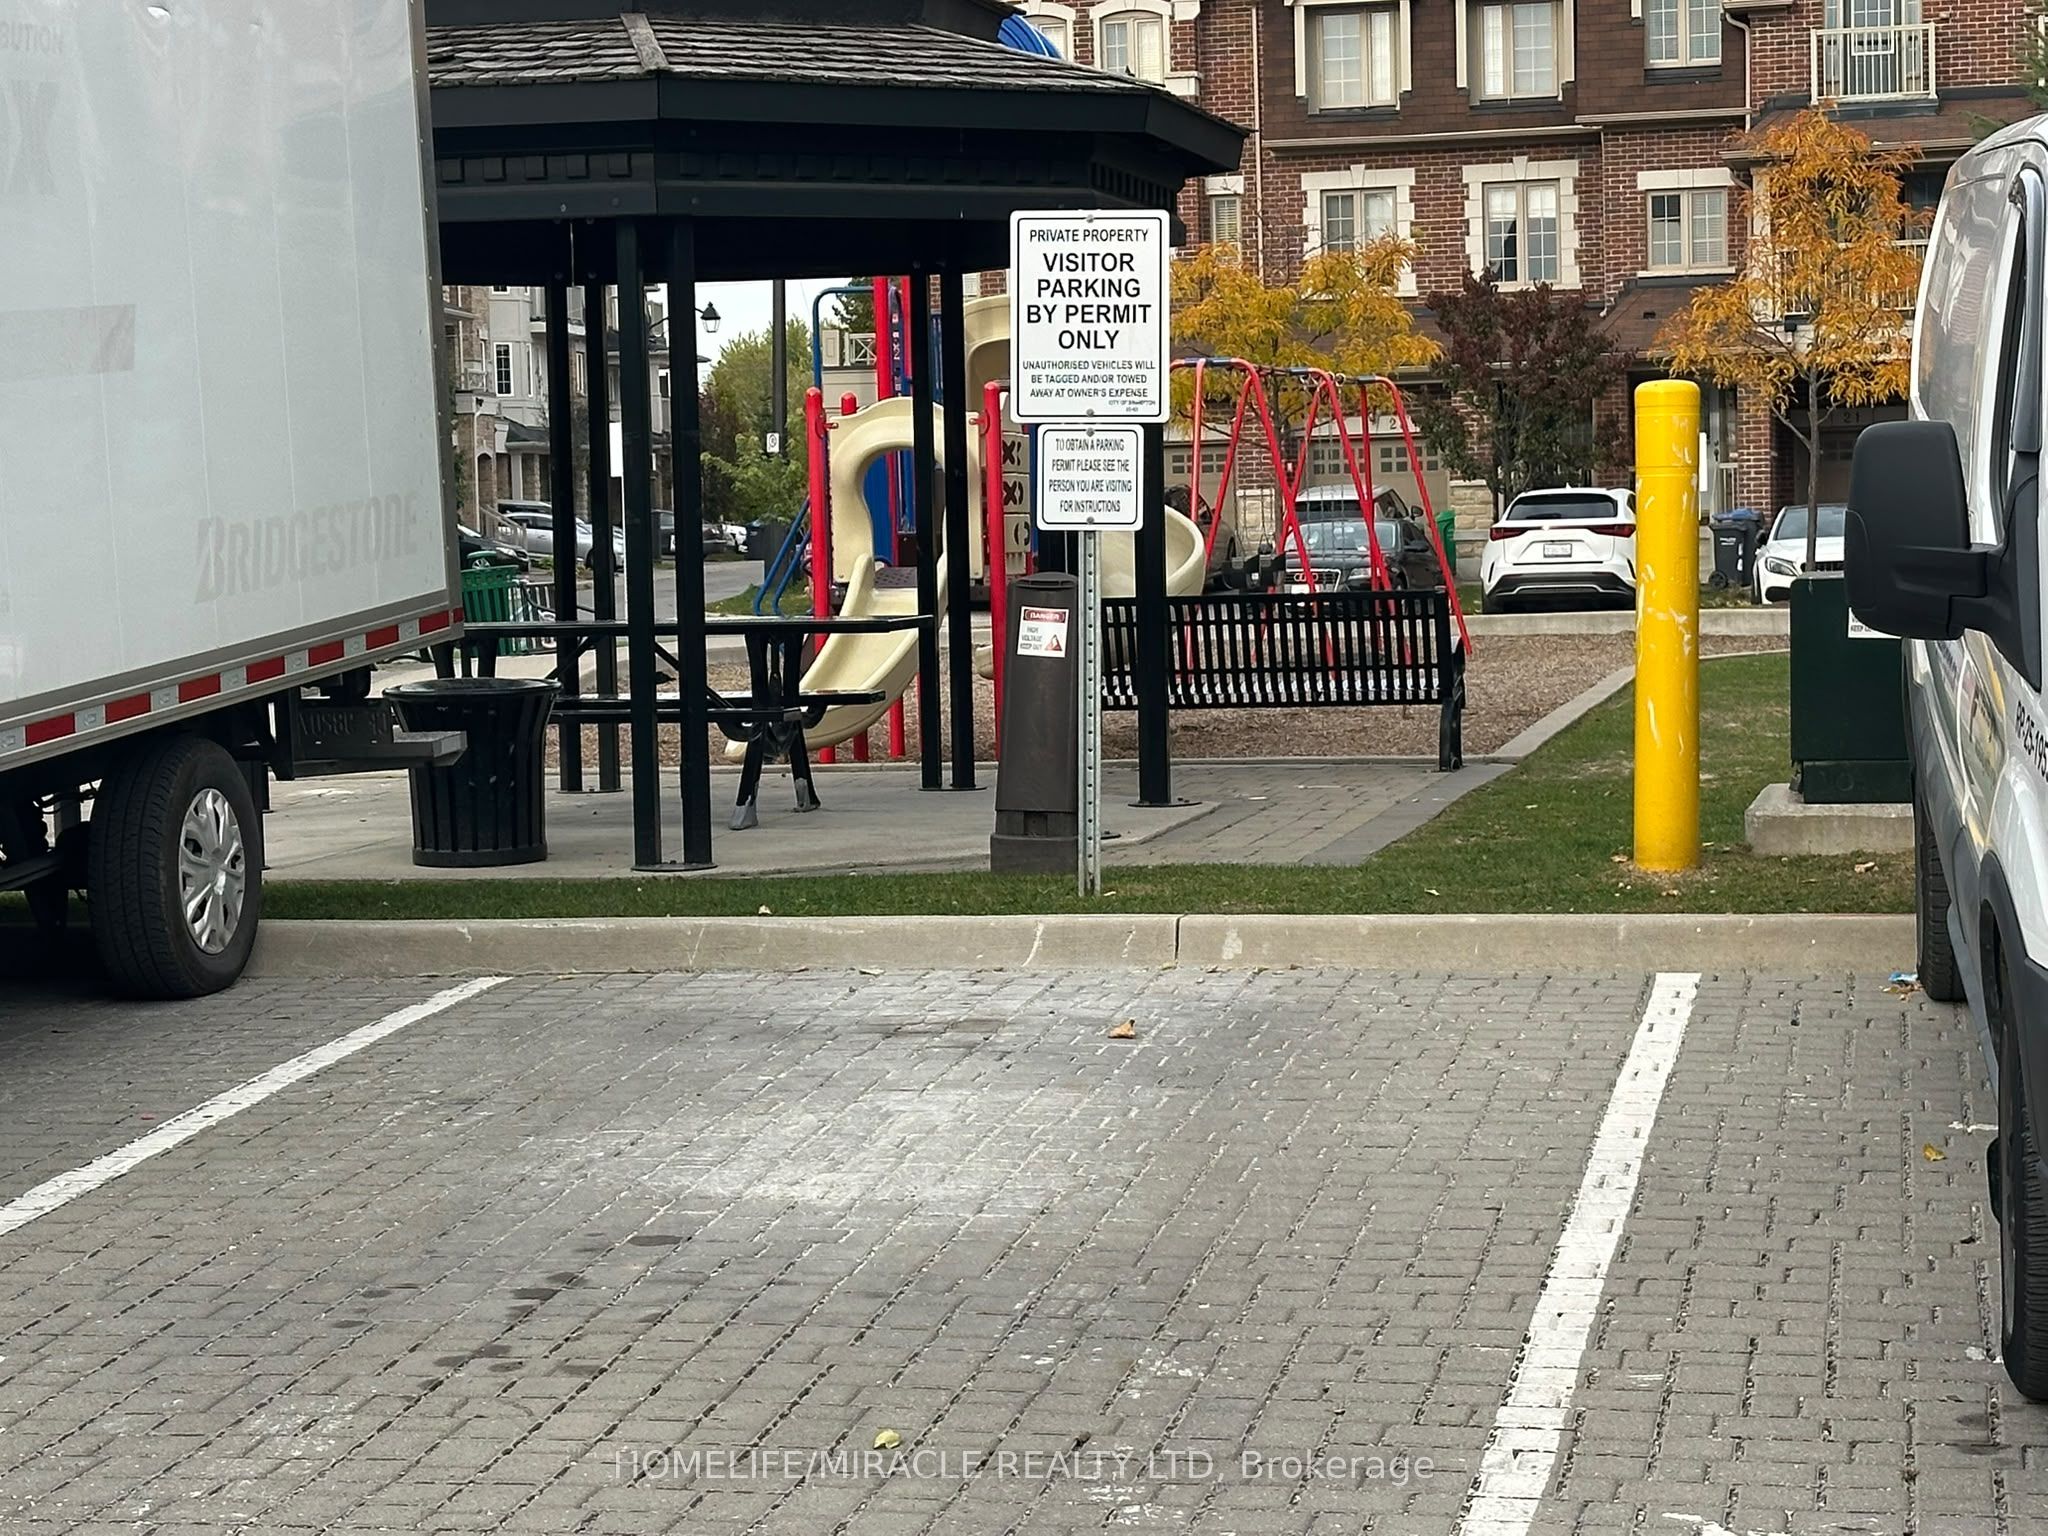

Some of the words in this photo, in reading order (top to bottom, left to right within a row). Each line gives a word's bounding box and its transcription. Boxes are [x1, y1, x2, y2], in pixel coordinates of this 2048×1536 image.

[0, 79, 61, 196] X
[1029, 228, 1080, 242] PRIVATE
[1083, 228, 1149, 242] PROPERTY
[1042, 252, 1135, 273] VISITOR
[1037, 278, 1141, 298] PARKING
[1027, 304, 1058, 324] BY
[1065, 304, 1152, 324] PERMIT
[1058, 329, 1120, 350] ONLY
[1022, 360, 1090, 370] UNAUTHORISED
[1092, 360, 1133, 370] VEHICLES
[1134, 360, 1156, 370] WILL
[1031, 374, 1043, 384] BE
[1044, 374, 1080, 384] TAGGED
[1081, 374, 1115, 384] AND/OR
[1116, 374, 1148, 384] TOWED
[1030, 388, 1054, 398] AWAY
[1055, 388, 1066, 398] AT
[1067, 388, 1107, 398] OWNER'S
[1108, 388, 1148, 398] EXPENSE
[1055, 438, 1065, 451] TO
[1065, 438, 1090, 452] OBTAIN
[1095, 438, 1125, 452] PARKING
[1051, 458, 1076, 472] PERMIT
[1076, 458, 1102, 472] PLEASE
[1102, 458, 1116, 472] SEE
[1117, 458, 1130, 472] THE
[1048, 478, 1076, 493] PERSON
[1076, 478, 1090, 493] YOU
[1090, 478, 1105, 493] ARE
[1105, 478, 1133, 493] VISITING
[1059, 499, 1073, 513] FOR
[1074, 499, 1121, 513] INSTRUCTIONS
[195, 488, 420, 605] BRIDGESTONE
[1029, 612, 1060, 621] DANGER
